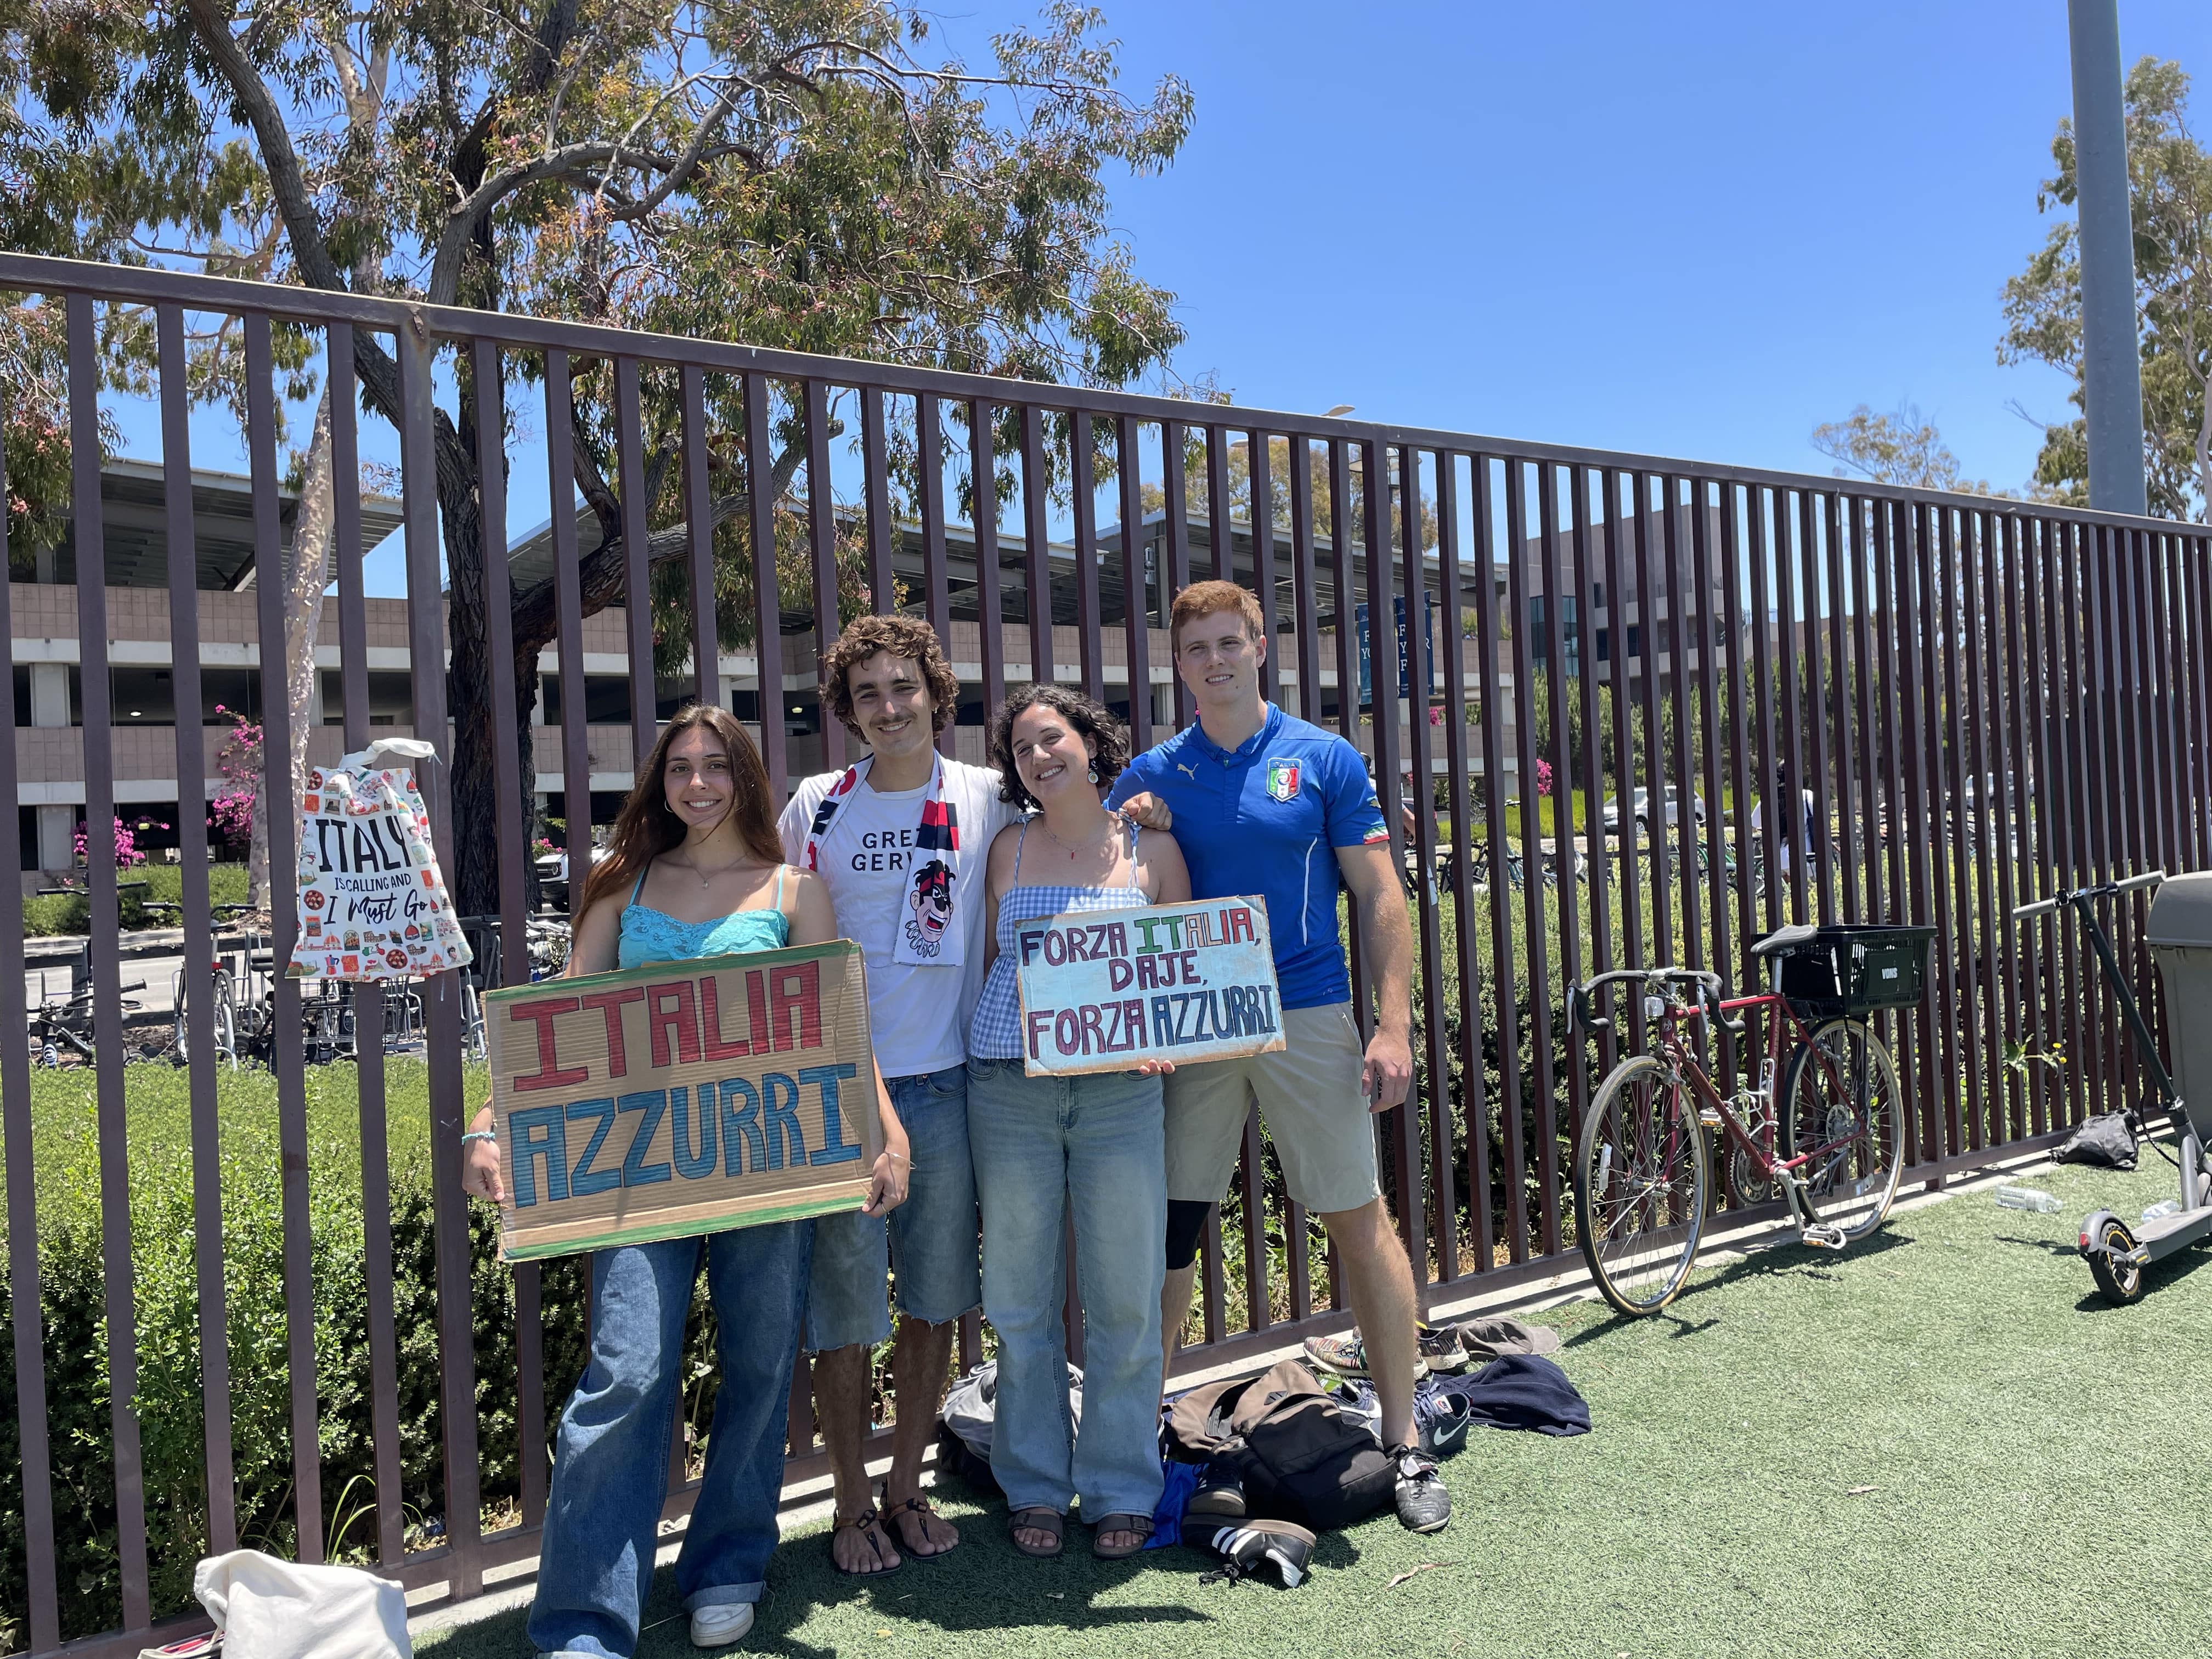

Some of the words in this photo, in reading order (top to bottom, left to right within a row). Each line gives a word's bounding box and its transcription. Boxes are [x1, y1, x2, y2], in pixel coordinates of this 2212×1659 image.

[315, 815, 411, 873] ITALY
[862, 828, 920, 849] GRE
[335, 877, 346, 889] IS
[346, 877, 390, 892] CALLING
[392, 873, 411, 887] AND
[851, 851, 912, 872] GER
[323, 895, 338, 925] I
[348, 893, 398, 924] Must
[404, 889, 428, 921] Go
[1020, 922, 1128, 967] FORZA
[1133, 907, 1261, 955] ITALIA,
[1108, 949, 1208, 992] DAJE,
[1882, 967, 1898, 979] VONS
[510, 960, 822, 1092] ITALIA
[1028, 998, 1148, 1059] FORZA
[1151, 985, 1277, 1047] AZZURRI
[508, 1063, 862, 1209] AZZURRI
